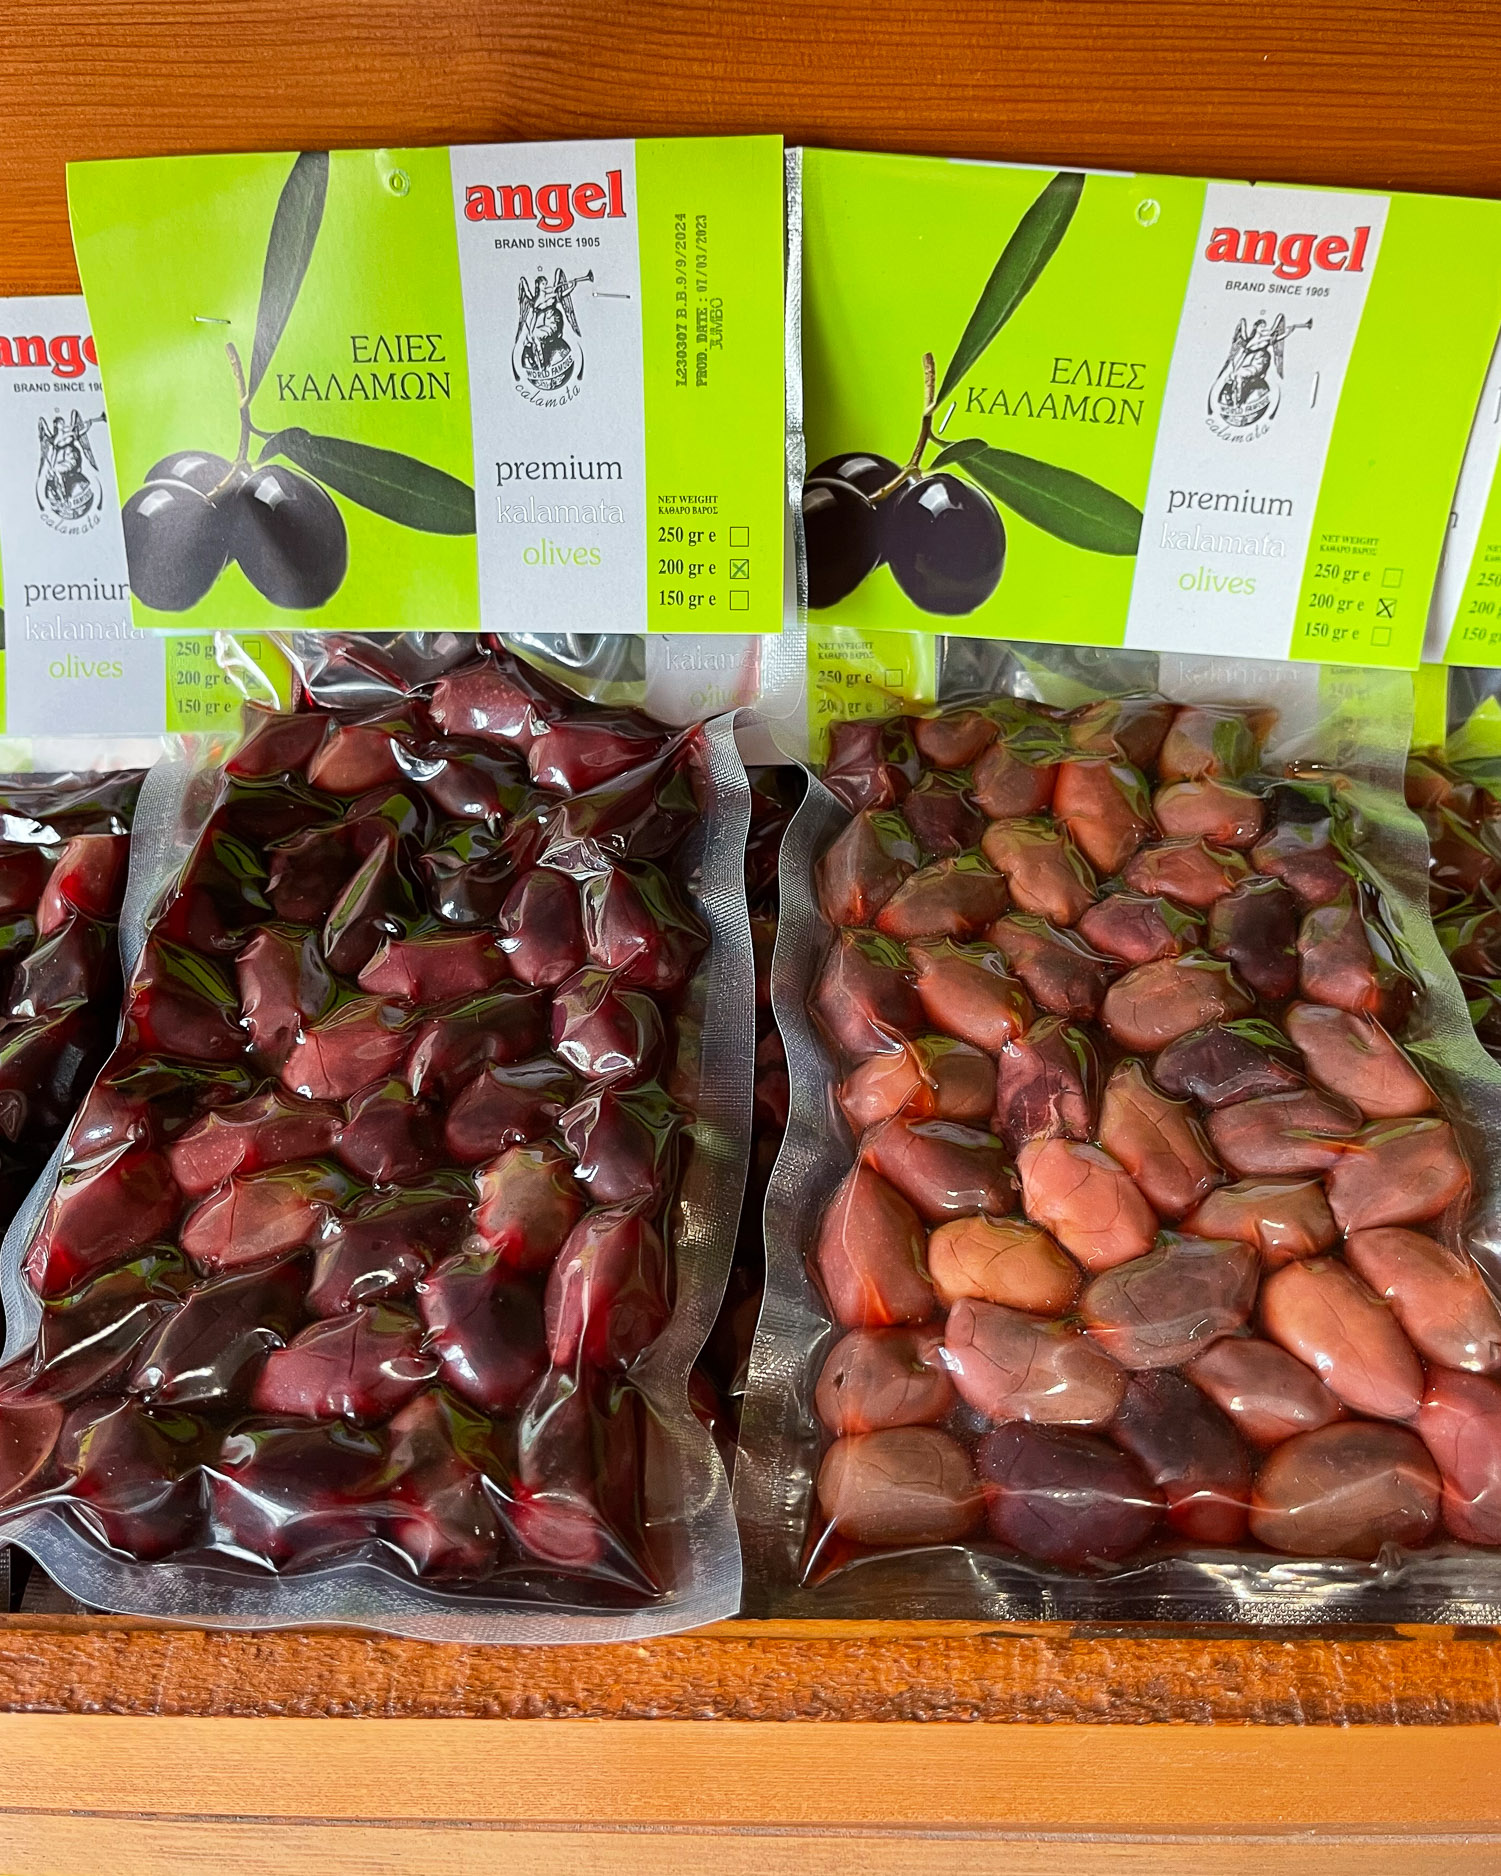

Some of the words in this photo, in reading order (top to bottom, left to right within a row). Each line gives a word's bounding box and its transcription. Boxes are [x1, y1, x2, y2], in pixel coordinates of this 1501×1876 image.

[464, 169, 627, 233] angel
[494, 238, 534, 249] BRAND
[538, 237, 572, 248] SINCE
[575, 237, 600, 247] 1905
[696, 215, 707, 292] 07/03/2023
[1205, 226, 1371, 280] angel
[1225, 281, 1265, 293] BRAND
[1268, 284, 1301, 295] SINCE
[1305, 287, 1330, 297] 1905
[710, 297, 723, 350] JUMBO
[0, 335, 98, 378] ang
[350, 334, 446, 363] ΕΛΙΕΣ
[526, 369, 550, 378] WORLD
[551, 355, 573, 375] FAMOUS
[1050, 357, 1146, 390] ΕΛΙΕΣ
[14, 382, 50, 392] BRAND
[53, 382, 85, 392] SINCE
[88, 382, 103, 392] 190
[276, 372, 450, 401] ΚΑΛΑΜΩΝ
[515, 384, 580, 408] calamata
[965, 386, 1145, 426] ΚΑΛΑΜΩΝ
[1205, 418, 1270, 443] calamata
[495, 454, 623, 487] premium
[495, 495, 625, 524] kalamata
[658, 495, 677, 504] NET
[679, 495, 719, 504] WEIGHT
[1166, 489, 1293, 517] premium
[40, 513, 101, 535] calamata
[658, 526, 684, 543] 250
[688, 531, 704, 547] gr
[1160, 521, 1286, 558] kalamata
[1321, 534, 1340, 543] NET
[1342, 535, 1379, 546] WEIGHT
[523, 537, 602, 566] olives
[658, 559, 684, 575] 200
[688, 563, 704, 579] gr
[1178, 565, 1257, 595] olives
[1314, 563, 1340, 579] 250
[1342, 568, 1360, 584] gr
[1477, 572, 1501, 587] 250
[659, 590, 684, 606] 150
[688, 594, 704, 610] gr
[1309, 593, 1334, 609] 200
[1336, 598, 1354, 614] gr
[1468, 601, 1495, 614] 200
[25, 614, 145, 641] kalamata
[1304, 622, 1329, 637] 150
[1331, 627, 1349, 643] gr
[1463, 627, 1487, 640] 150
[176, 641, 200, 656] 250
[49, 653, 123, 679] olives
[176, 671, 200, 685] 200
[204, 675, 220, 689] gr
[818, 670, 842, 684] 250
[846, 673, 861, 688] gr
[177, 699, 200, 713] 150
[205, 704, 220, 716] gr
[817, 699, 842, 714] 20
